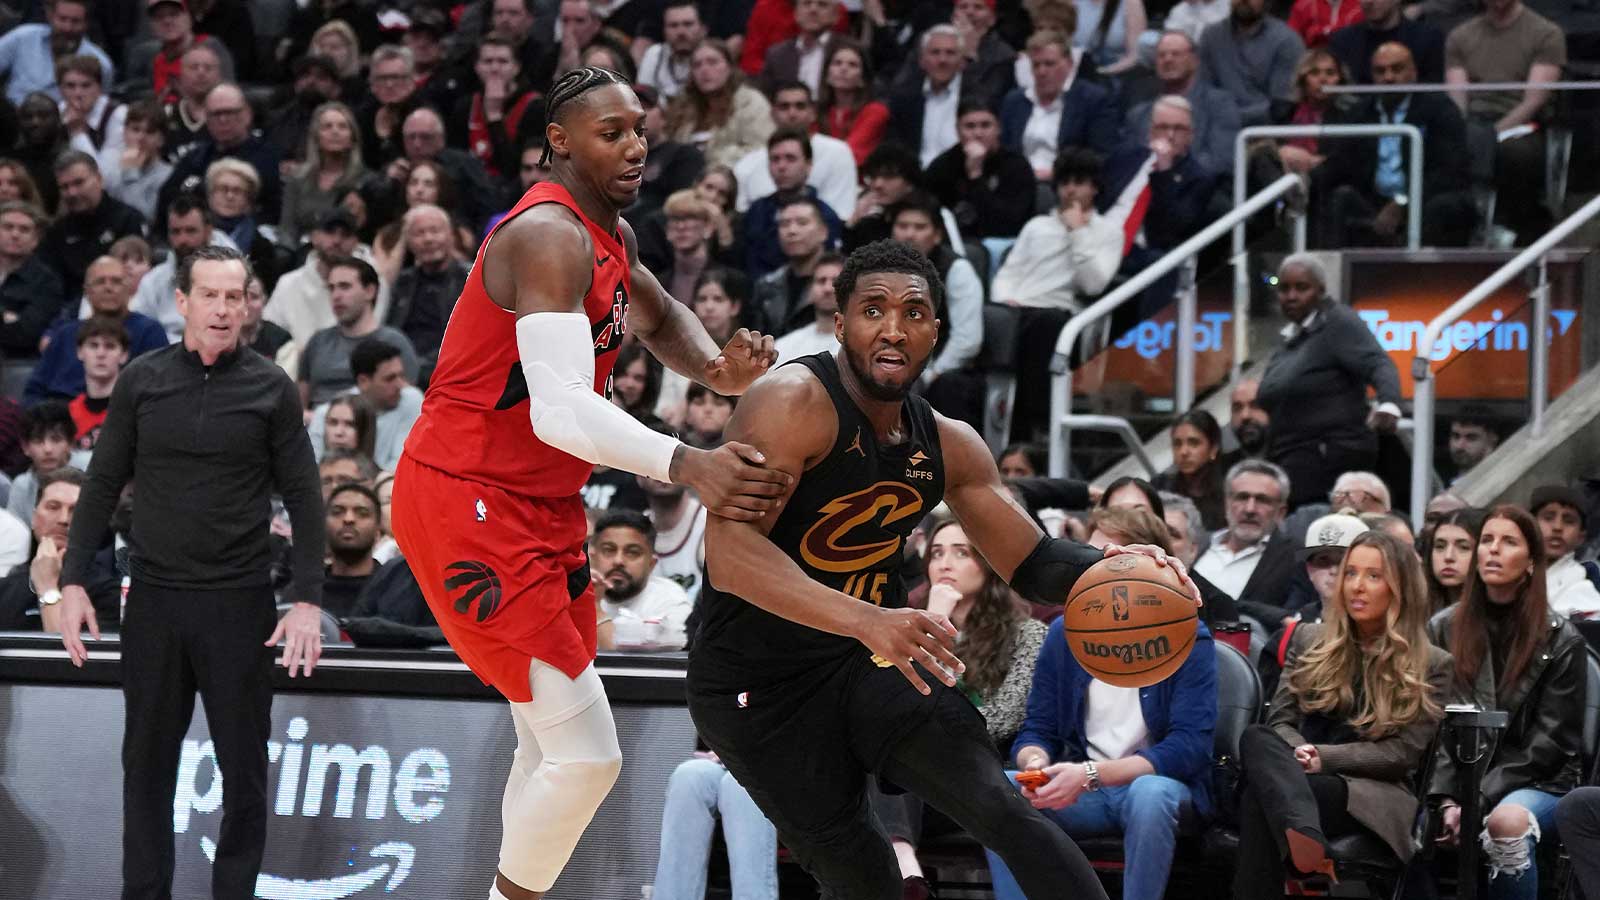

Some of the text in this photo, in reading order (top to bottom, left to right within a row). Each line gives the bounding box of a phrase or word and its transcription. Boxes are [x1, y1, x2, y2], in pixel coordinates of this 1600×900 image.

[1357, 309, 1553, 361] Tangerin
[906, 468, 933, 480] CLIFFS
[1082, 635, 1171, 664] Wilson
[173, 717, 450, 833] pime
